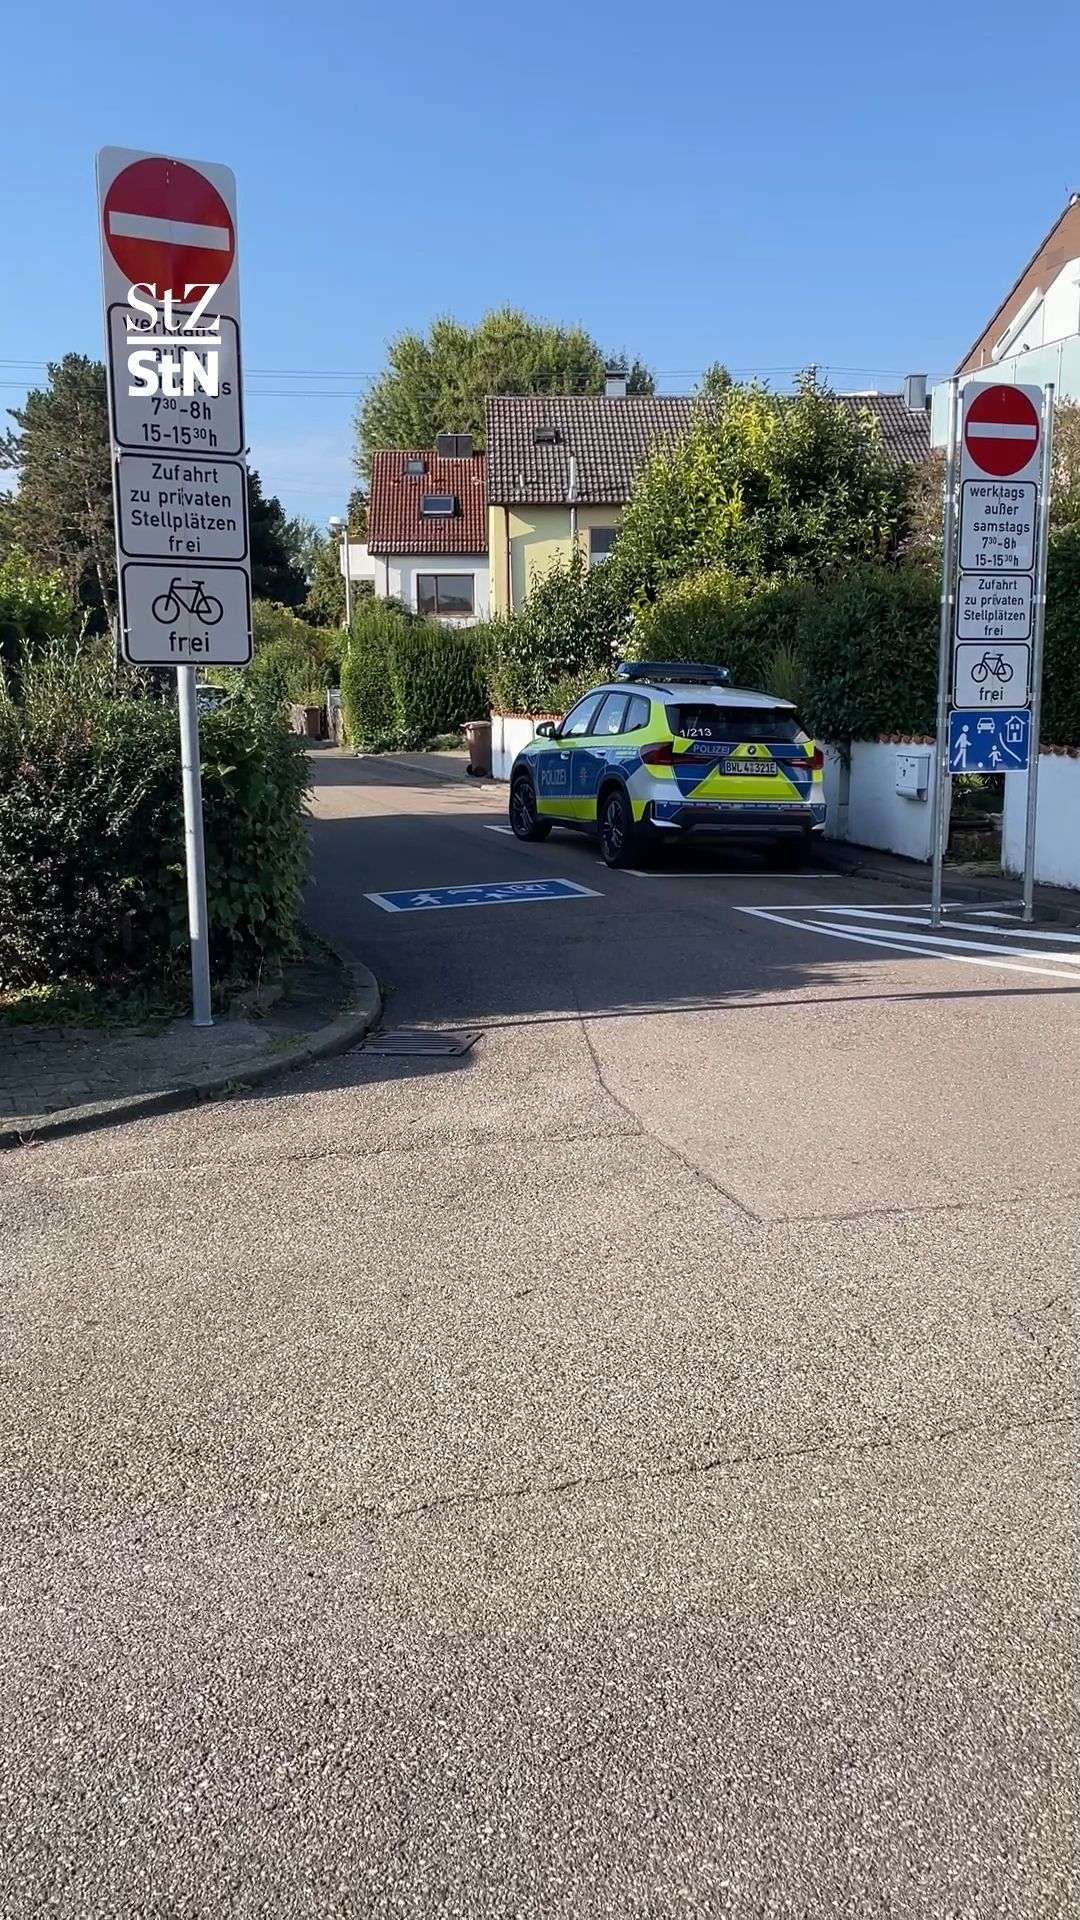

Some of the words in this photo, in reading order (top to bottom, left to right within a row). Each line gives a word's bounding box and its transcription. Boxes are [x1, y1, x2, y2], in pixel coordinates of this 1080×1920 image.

[152, 463, 218, 483] Zufahrt
[130, 489, 150, 502] zu
[159, 488, 231, 508] privaten
[970, 485, 1025, 501] werktags
[984, 502, 1019, 515] außer
[131, 509, 236, 532] Stellplätzen
[973, 521, 1030, 536] samstags
[168, 536, 201, 553] frei
[978, 579, 1017, 590] Zufahrt
[964, 596, 977, 605] zu
[981, 594, 1024, 607] privaten
[963, 609, 1026, 622] Stellplätzen
[984, 625, 1004, 636] frei
[169, 631, 209, 652] frei
[979, 687, 1004, 701] frei
[679, 728, 712, 738] 1/213
[693, 744, 730, 754] POLIZEI
